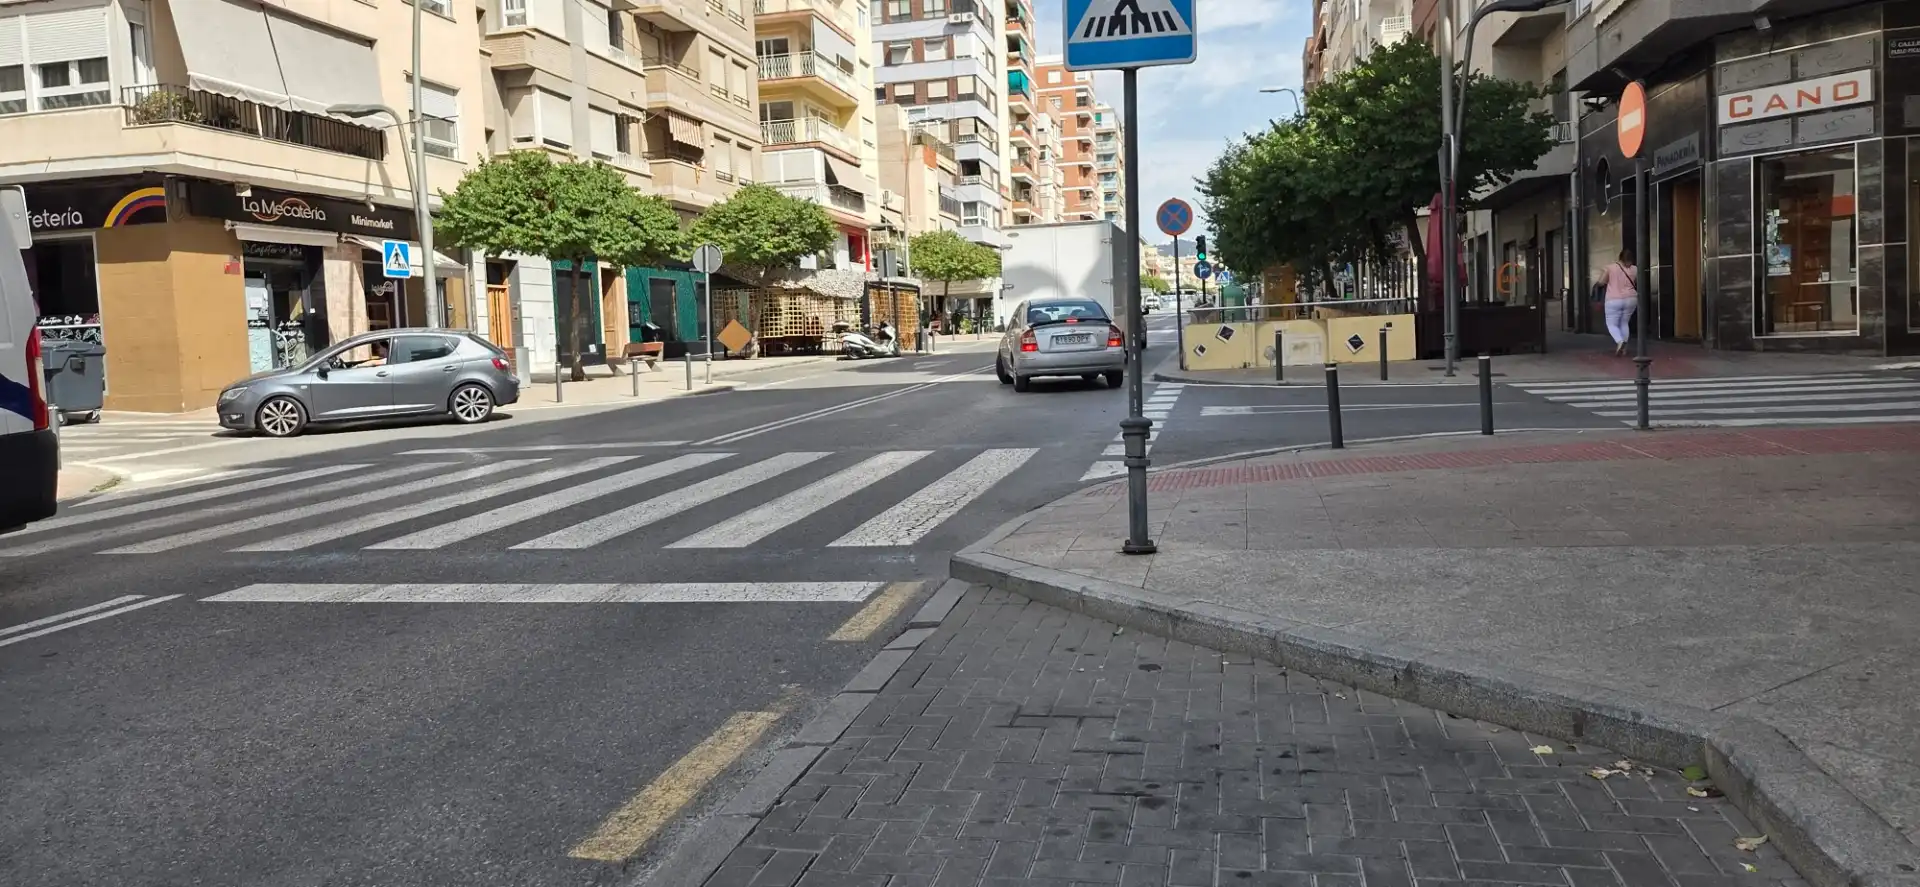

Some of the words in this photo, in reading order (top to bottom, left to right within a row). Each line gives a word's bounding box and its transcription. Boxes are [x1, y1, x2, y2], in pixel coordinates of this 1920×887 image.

[1729, 80, 1859, 119] CANO
[243, 196, 259, 212] La
[262, 199, 326, 221] Mecatería
[351, 214, 394, 230] Minimarket
